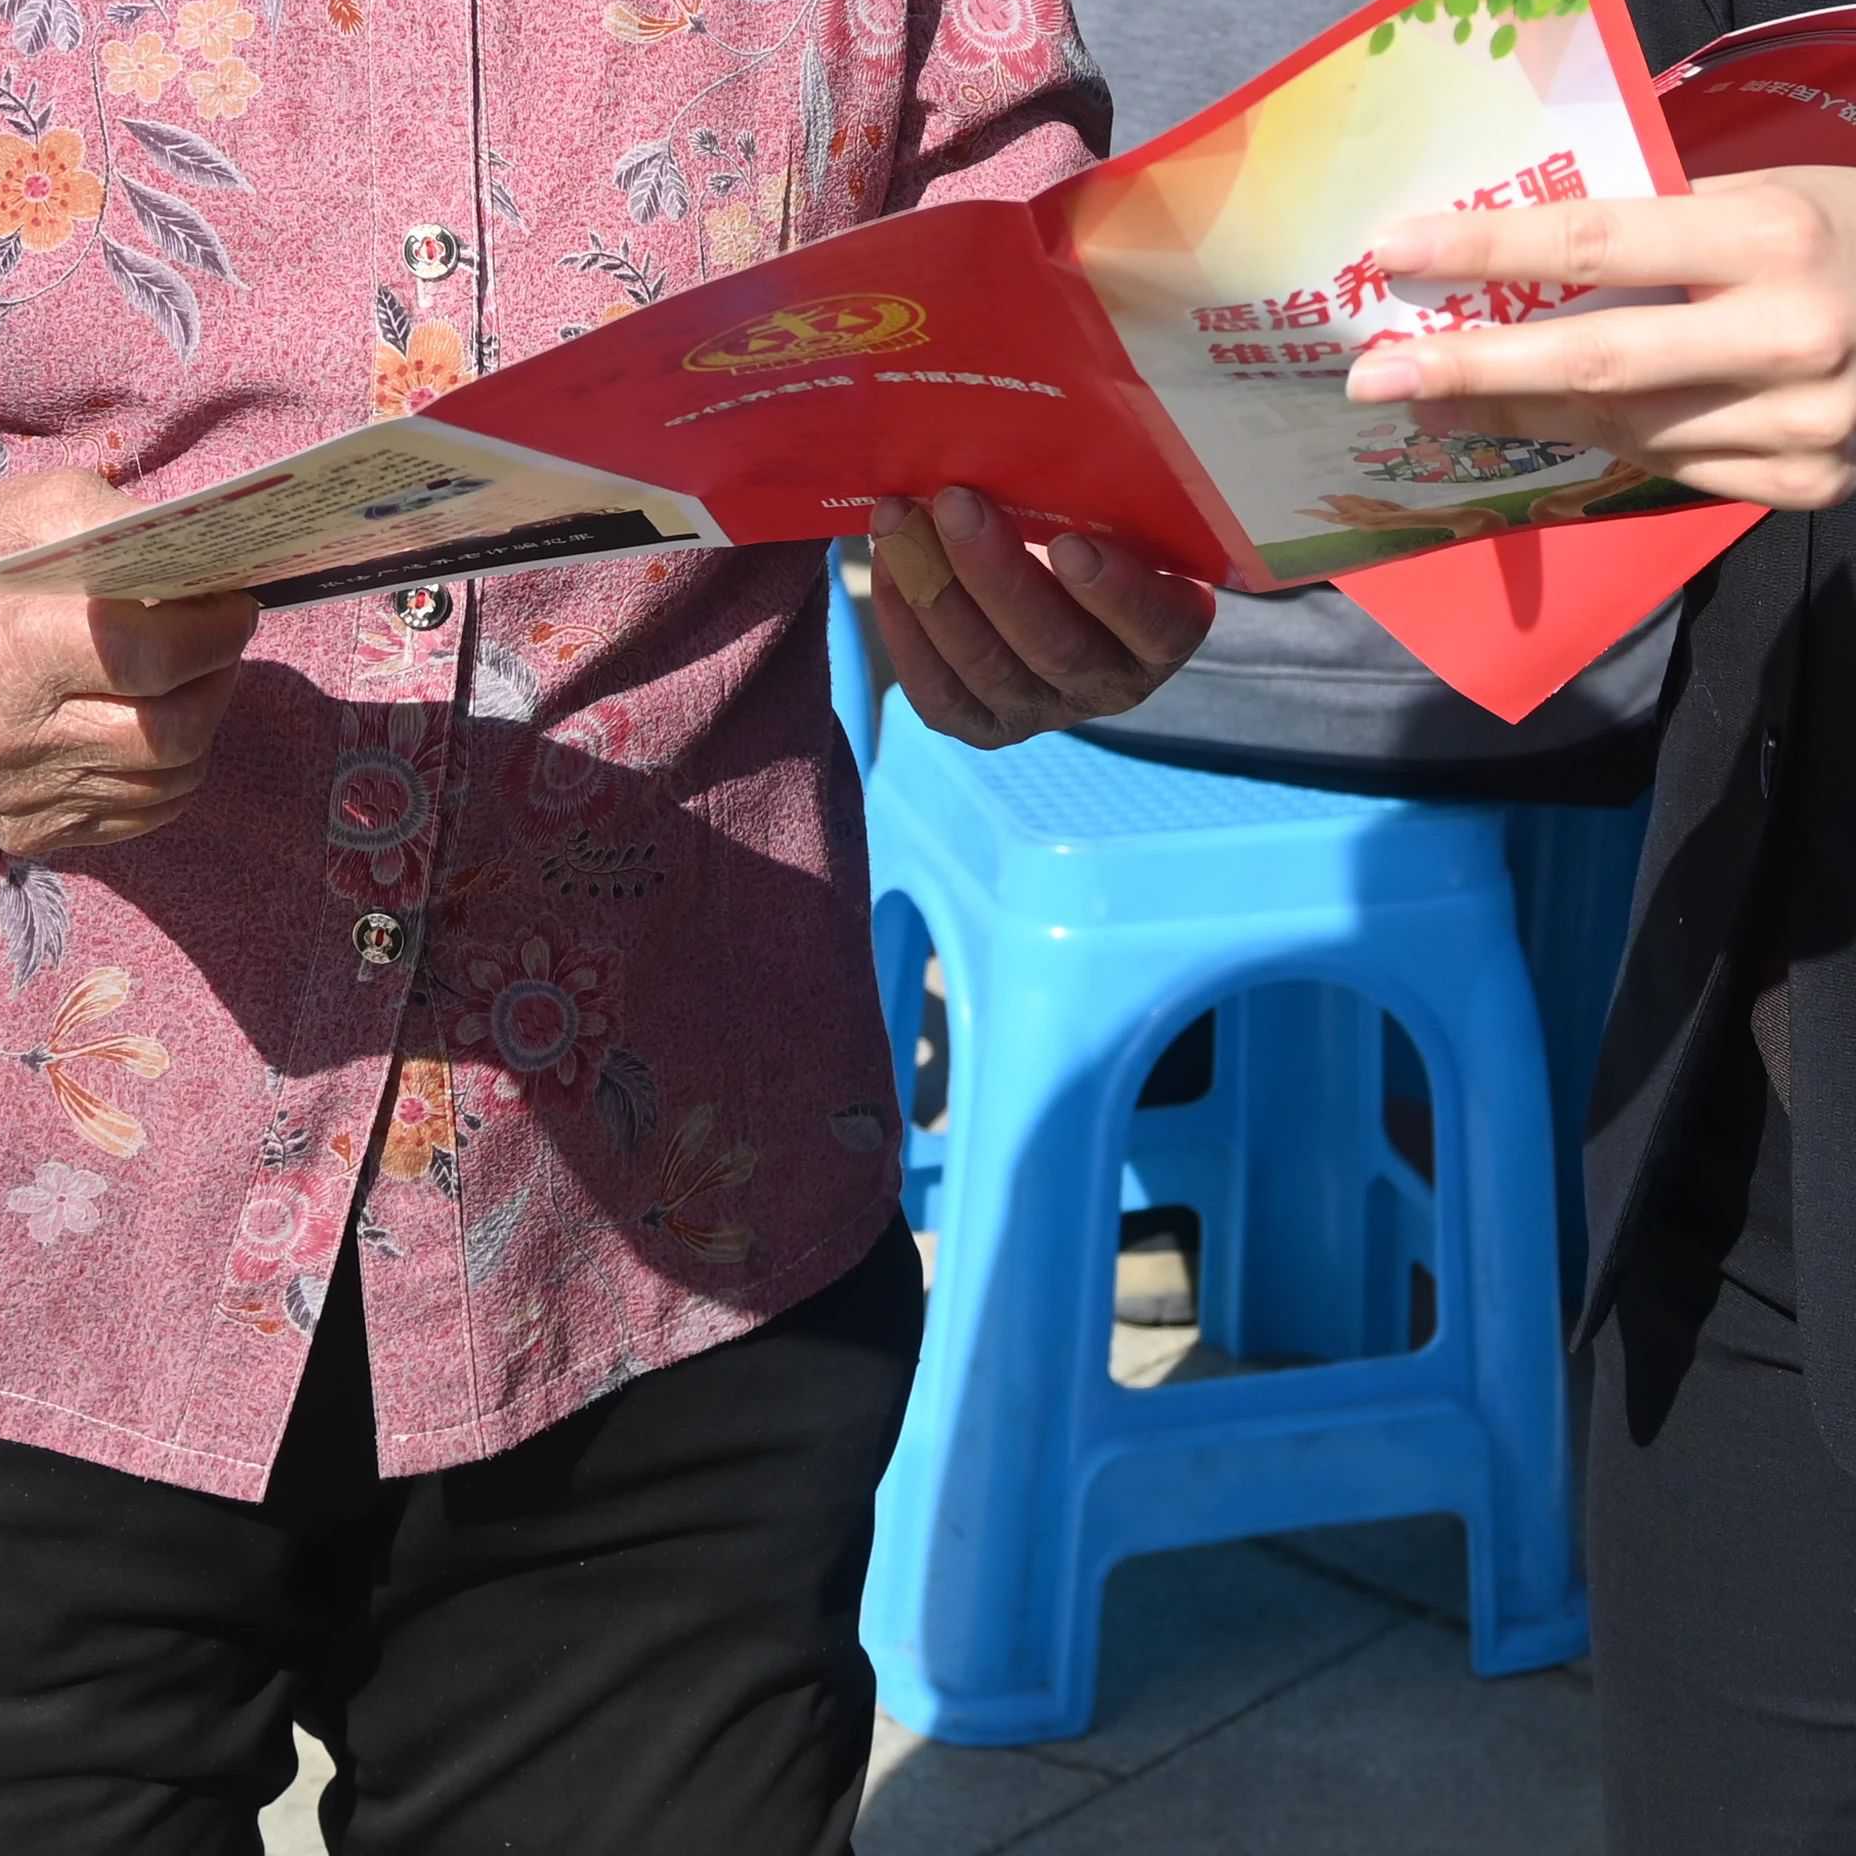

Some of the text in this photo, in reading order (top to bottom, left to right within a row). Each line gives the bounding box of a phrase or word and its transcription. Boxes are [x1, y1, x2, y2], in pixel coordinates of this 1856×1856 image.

[1190, 149, 1589, 334] 惩治养诈骗
